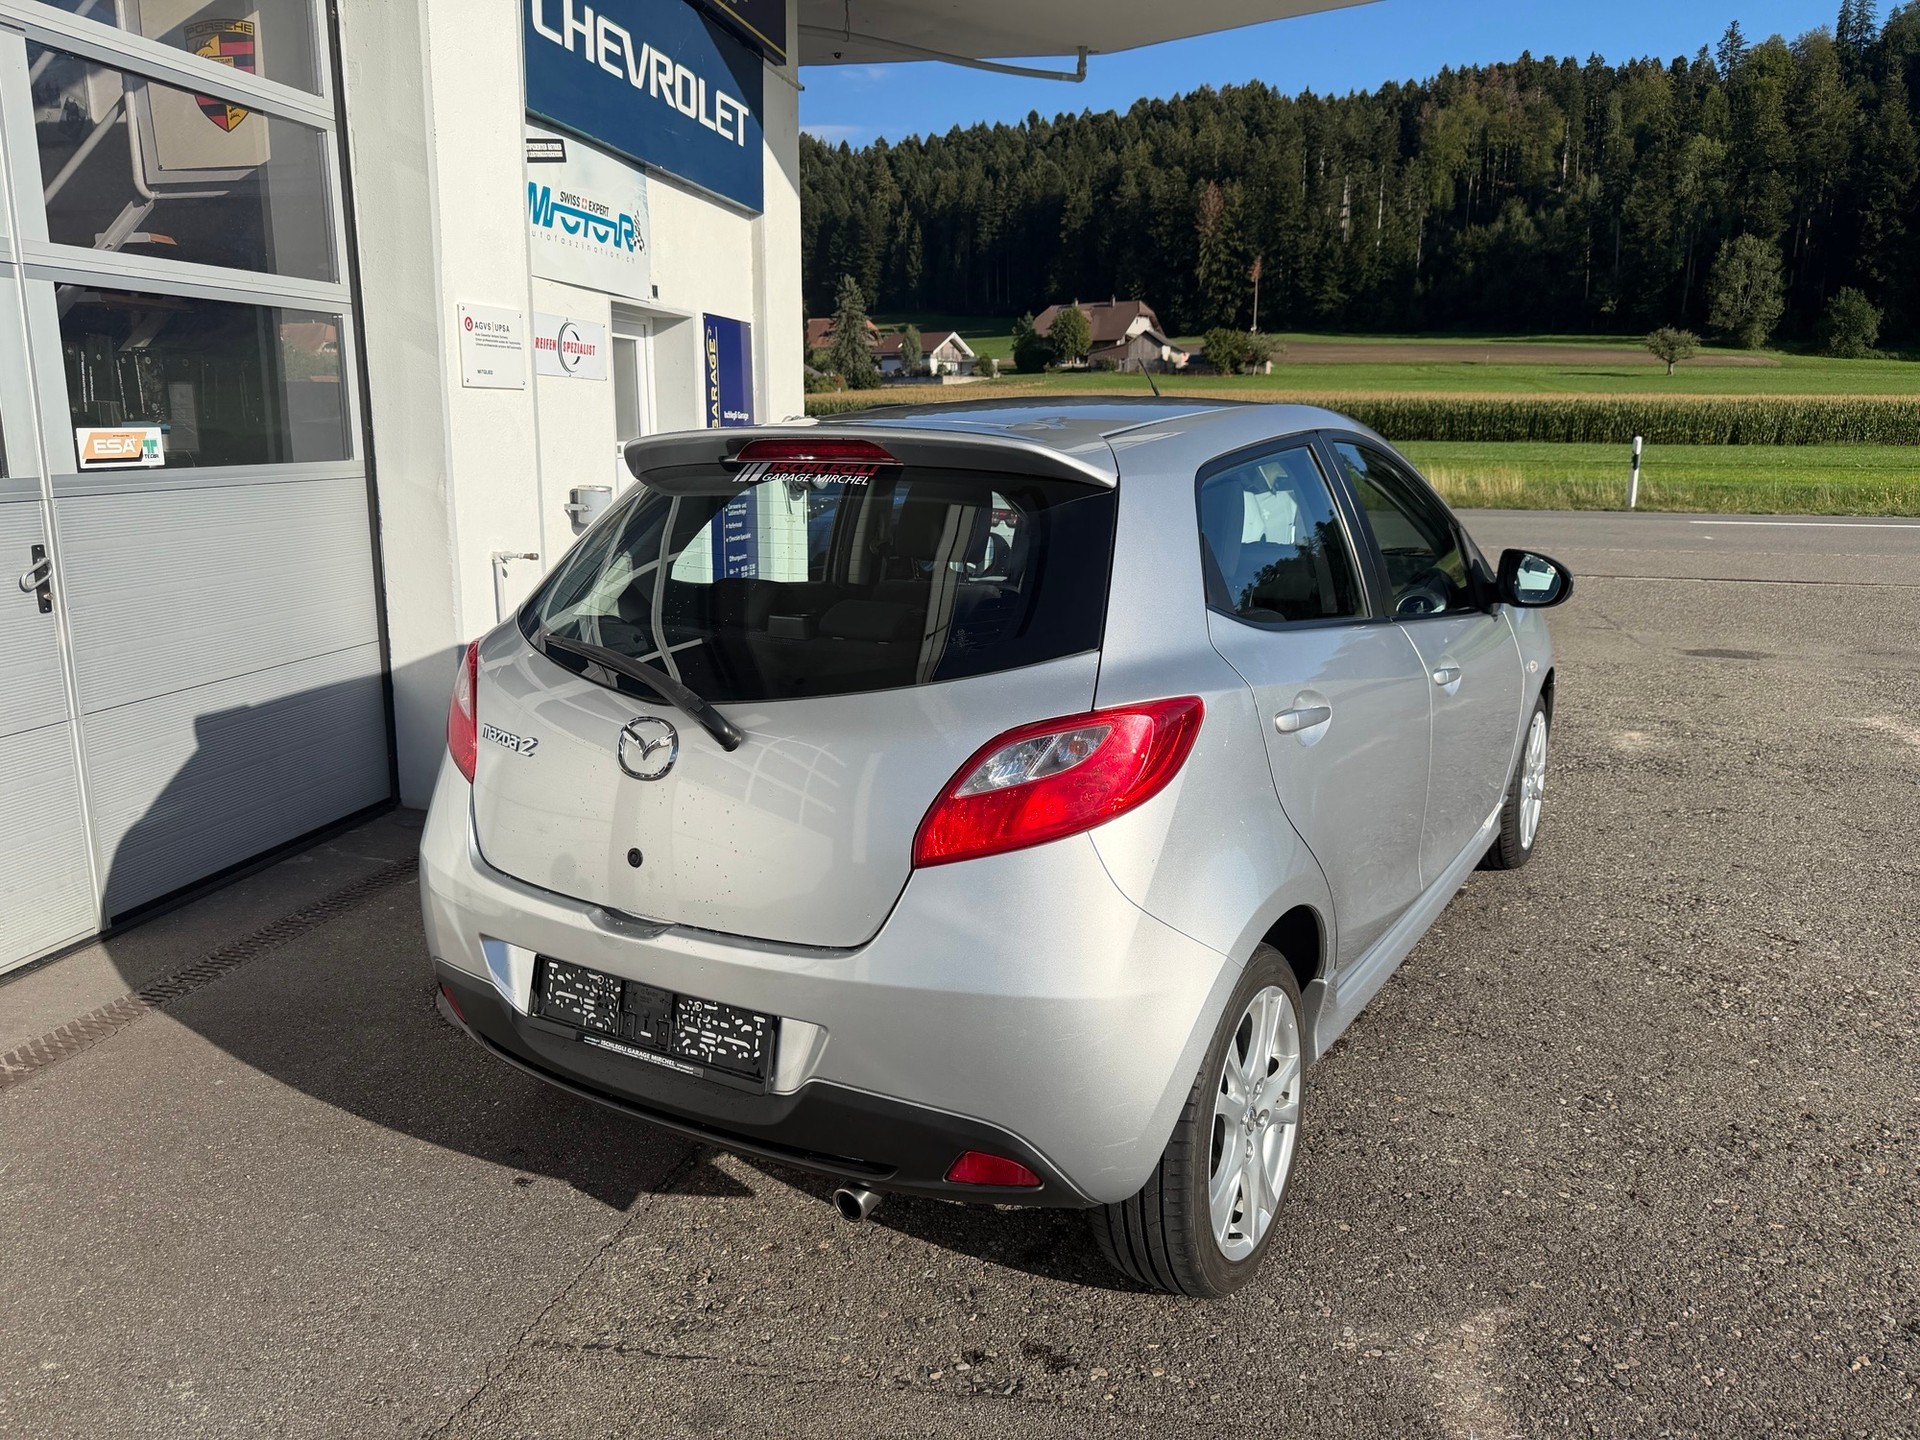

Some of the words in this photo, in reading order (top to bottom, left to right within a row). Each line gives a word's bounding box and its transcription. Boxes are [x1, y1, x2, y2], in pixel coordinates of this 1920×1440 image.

[186, 21, 252, 35] PORSCHE
[532, 0, 749, 147] CHEVROLET
[559, 191, 581, 208] SWISS
[588, 200, 610, 217] EXPERT
[528, 181, 635, 253] MOTOR
[531, 230, 636, 264] utofaszination.ch
[474, 321, 492, 331] AGVS
[494, 323, 511, 333] UPSA
[535, 336, 557, 351] REIFEN
[562, 340, 596, 356] SPEZIALIST
[762, 472, 813, 482] GARAGE
[817, 473, 869, 486] MIRCHEL
[768, 462, 881, 476] ISCHLEGLI
[600, 1039, 627, 1052] ISCHLEGLI
[627, 1046, 650, 1059] GARAGE
[651, 1054, 676, 1067] MIRCHEL
